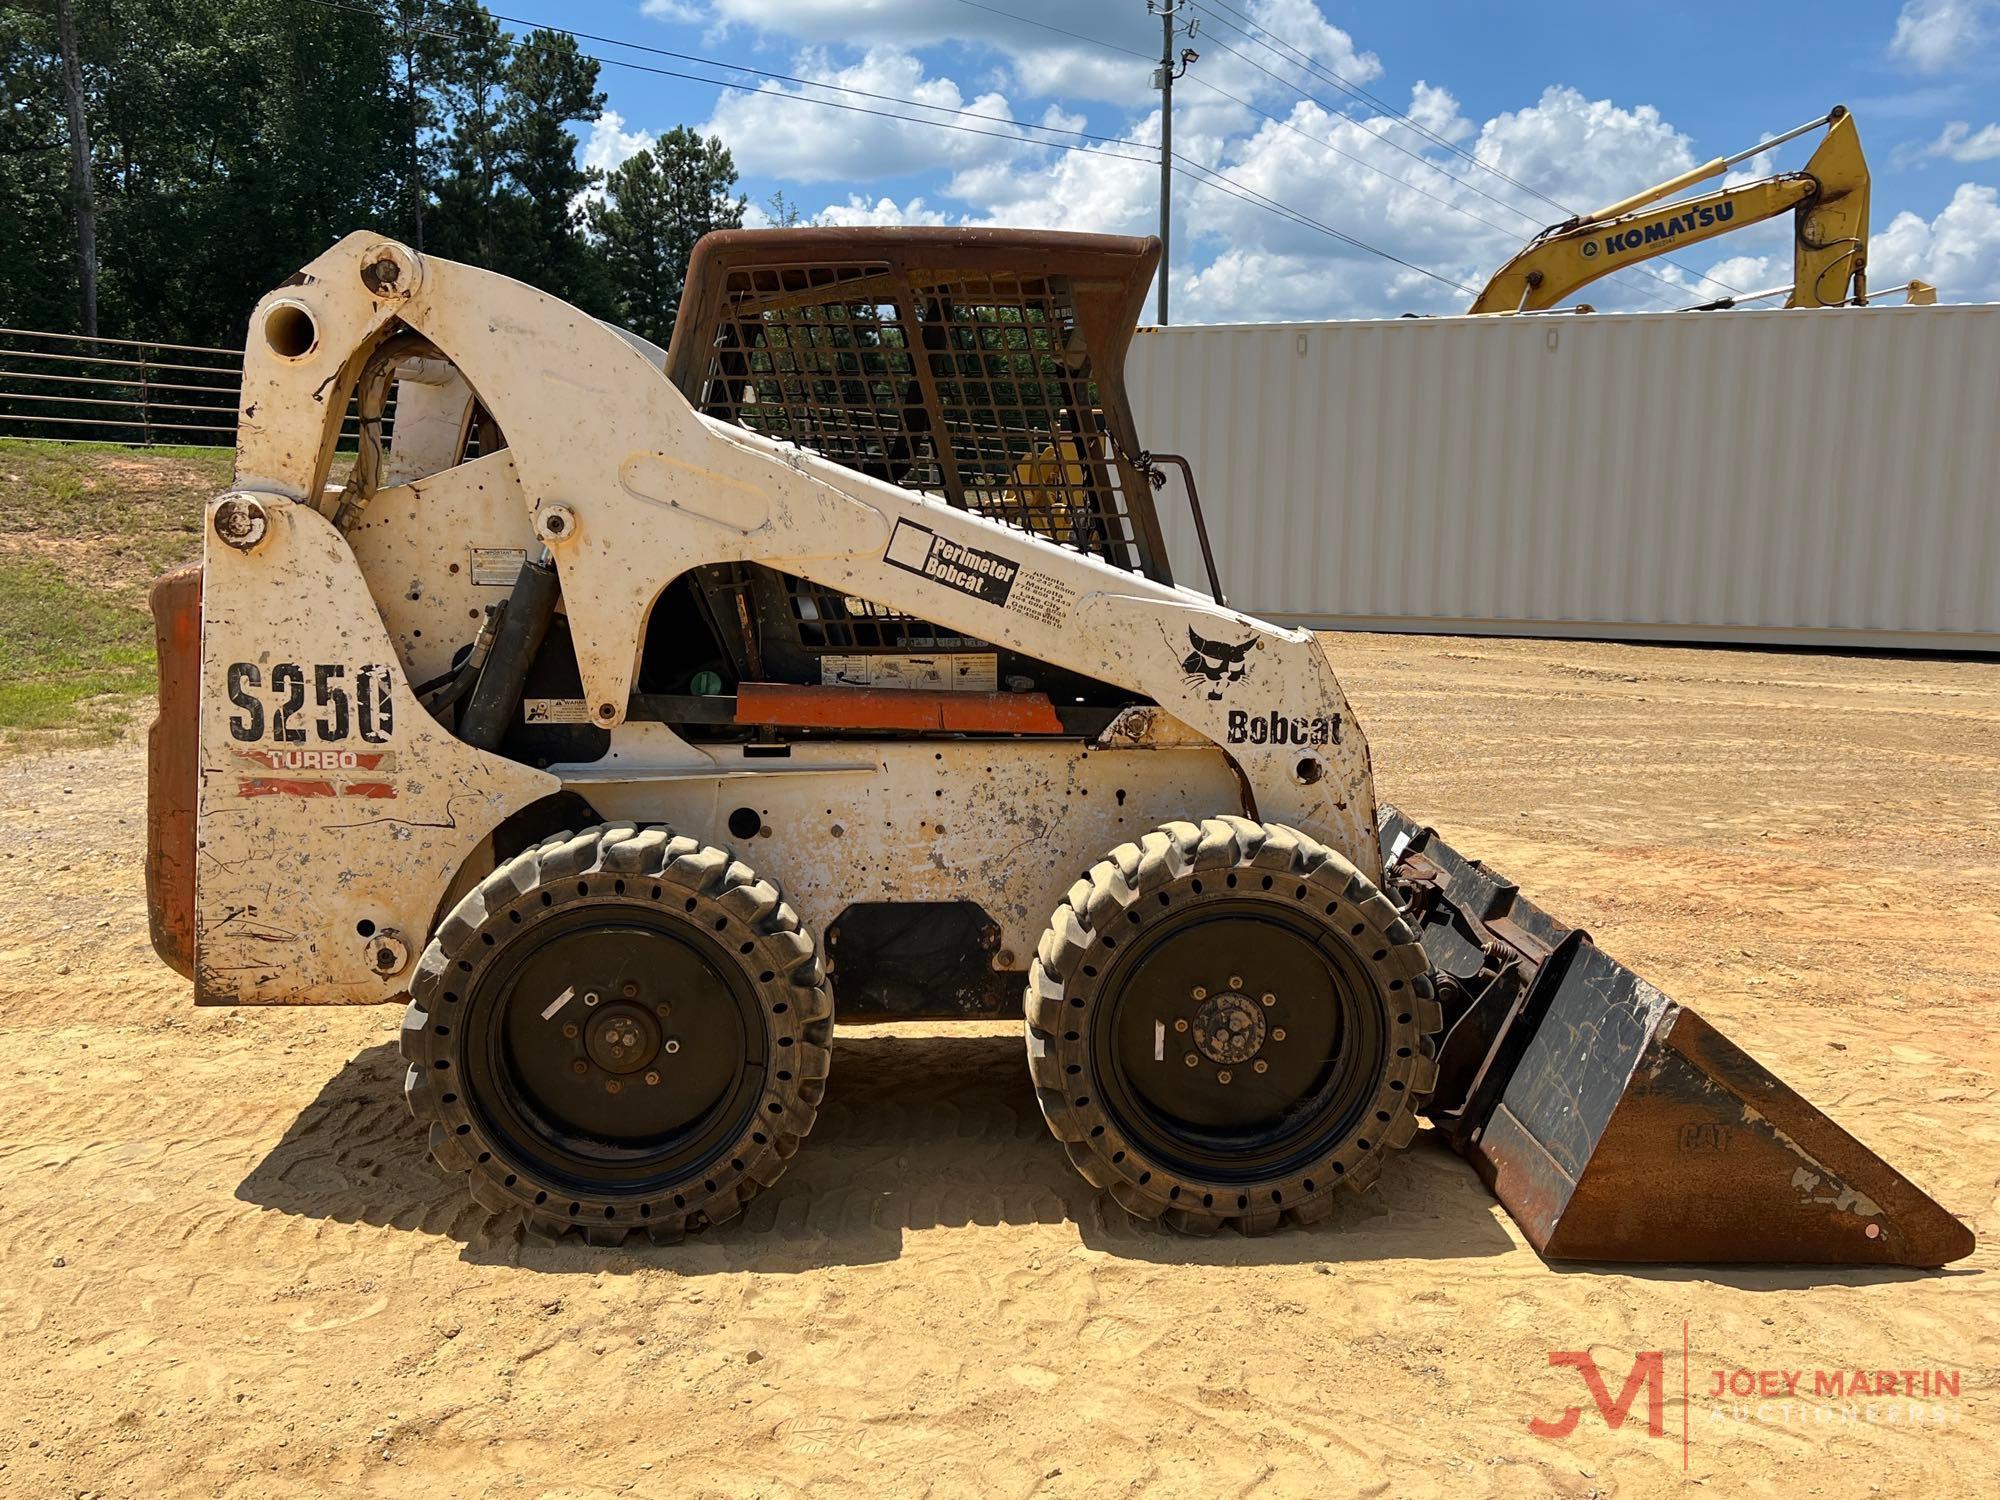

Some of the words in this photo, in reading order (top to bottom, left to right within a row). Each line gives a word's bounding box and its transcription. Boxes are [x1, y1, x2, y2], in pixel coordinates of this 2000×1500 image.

[1605, 201, 1734, 255] KOMATSU
[924, 557, 985, 594] Bobcat
[932, 537, 1015, 583] Perimeter
[1020, 591, 1042, 603] Lake
[1025, 580, 1064, 599] Marietta
[1033, 571, 1065, 587] Atlanta
[227, 662, 394, 744] S250
[1227, 710, 1343, 746] Bobcat
[266, 750, 358, 770] TURBO
